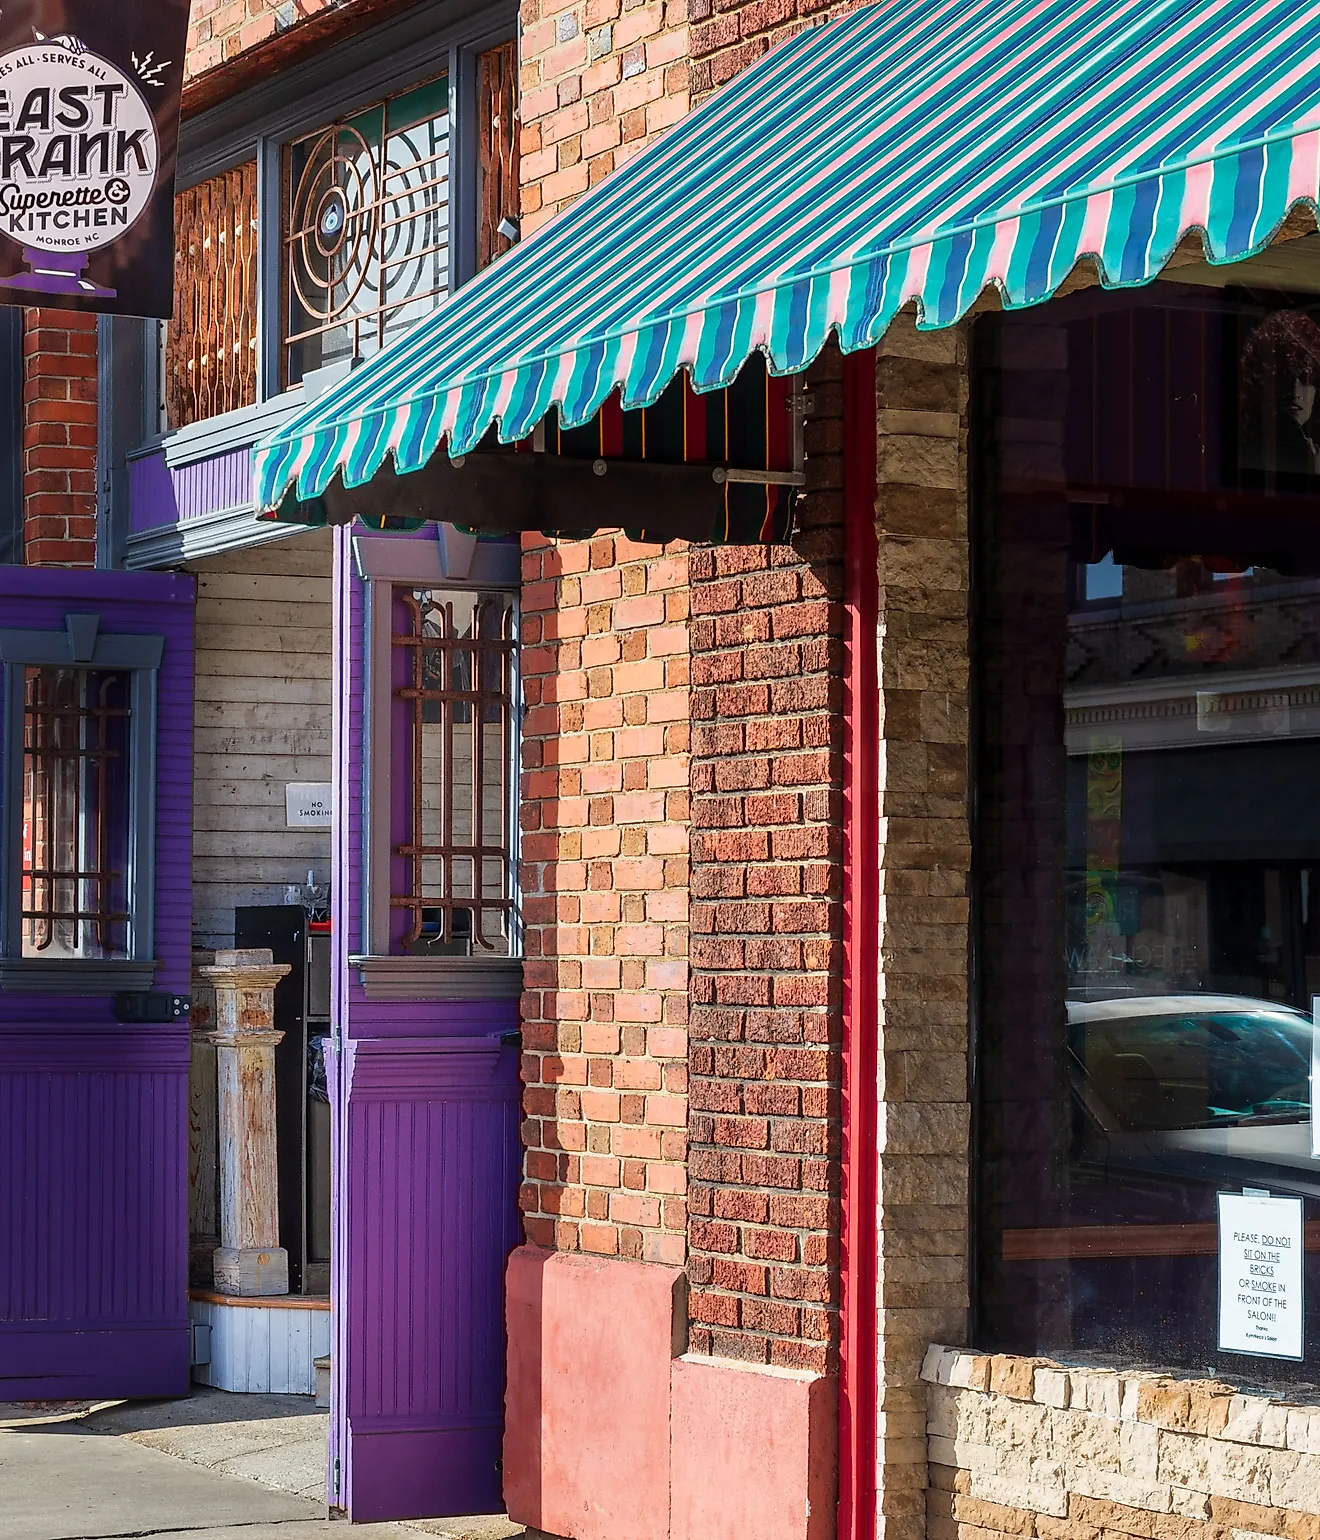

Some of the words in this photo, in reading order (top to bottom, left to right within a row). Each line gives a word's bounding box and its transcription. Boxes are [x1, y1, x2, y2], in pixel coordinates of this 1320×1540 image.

[16, 55, 35, 69] ALL
[42, 53, 86, 69] SERVES
[87, 65, 107, 81] ALL
[106, 179, 130, 204] &
[9, 206, 128, 232] KITCHEN
[36, 235, 81, 246] MONROE
[85, 233, 100, 243] NC
[1262, 1235, 1274, 1245] DO
[1276, 1237, 1291, 1247] NOT
[1244, 1248, 1253, 1258] SIT
[1254, 1250, 1266, 1260] ON
[1268, 1251, 1280, 1262] THE
[1249, 1264, 1274, 1275] BRICKS
[1238, 1278, 1250, 1288] OR
[1251, 1280, 1277, 1292] SMOKE
[1278, 1283, 1286, 1292] IN
[1237, 1294, 1261, 1305] FRONT
[1262, 1297, 1273, 1307] OF
[1274, 1298, 1287, 1309] THE
[1247, 1309, 1277, 1322] SALON!!
